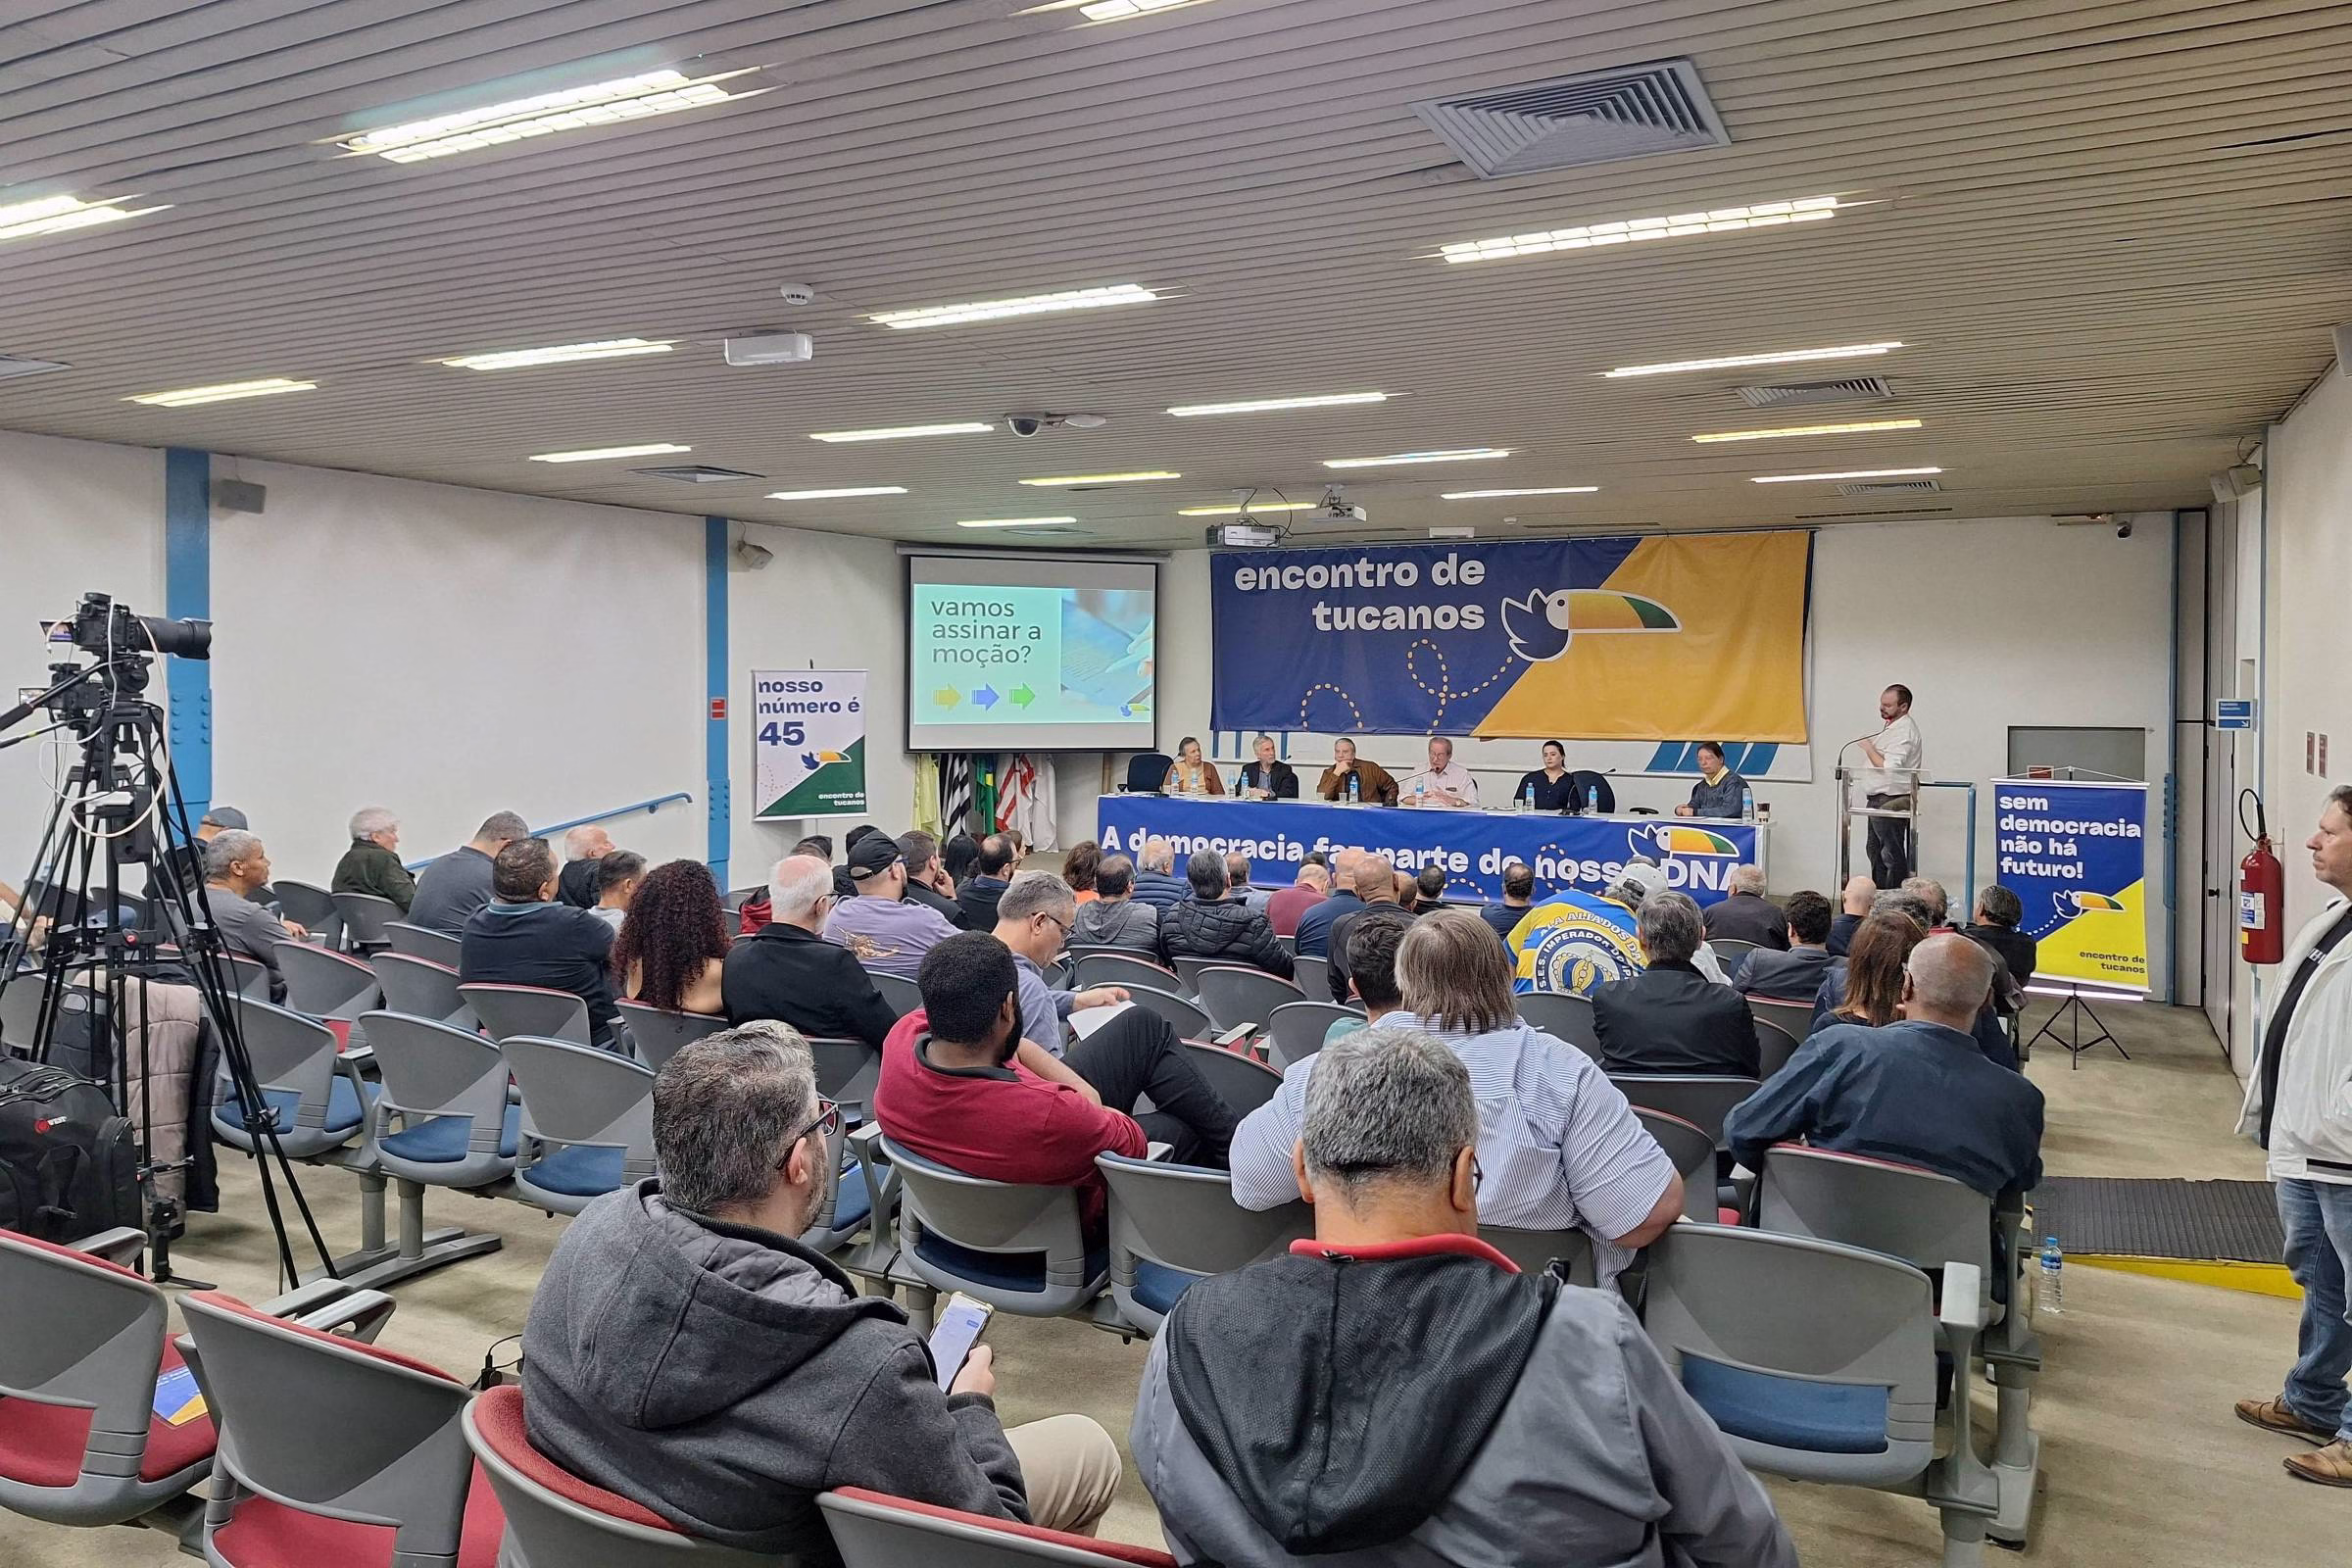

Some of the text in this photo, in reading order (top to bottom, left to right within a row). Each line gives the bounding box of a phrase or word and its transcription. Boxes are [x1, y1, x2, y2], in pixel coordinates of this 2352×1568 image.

[1234, 553, 1486, 591] encontro de
[931, 601, 1014, 617] vamos
[1311, 599, 1486, 632] tucanos
[932, 619, 1042, 640] assinar a
[932, 644, 1031, 668] moção?
[759, 680, 823, 693] nosso
[759, 697, 860, 713] número é
[759, 720, 806, 746] 45
[1999, 796, 2048, 810] sem
[2000, 814, 2141, 838] democracia
[1101, 825, 1121, 851] A
[1535, 854, 1623, 884] noss
[2000, 835, 2078, 857] não há
[2000, 857, 2083, 879] futuro!
[2080, 951, 2145, 964] encontro de
[2101, 962, 2145, 974] tucanos
